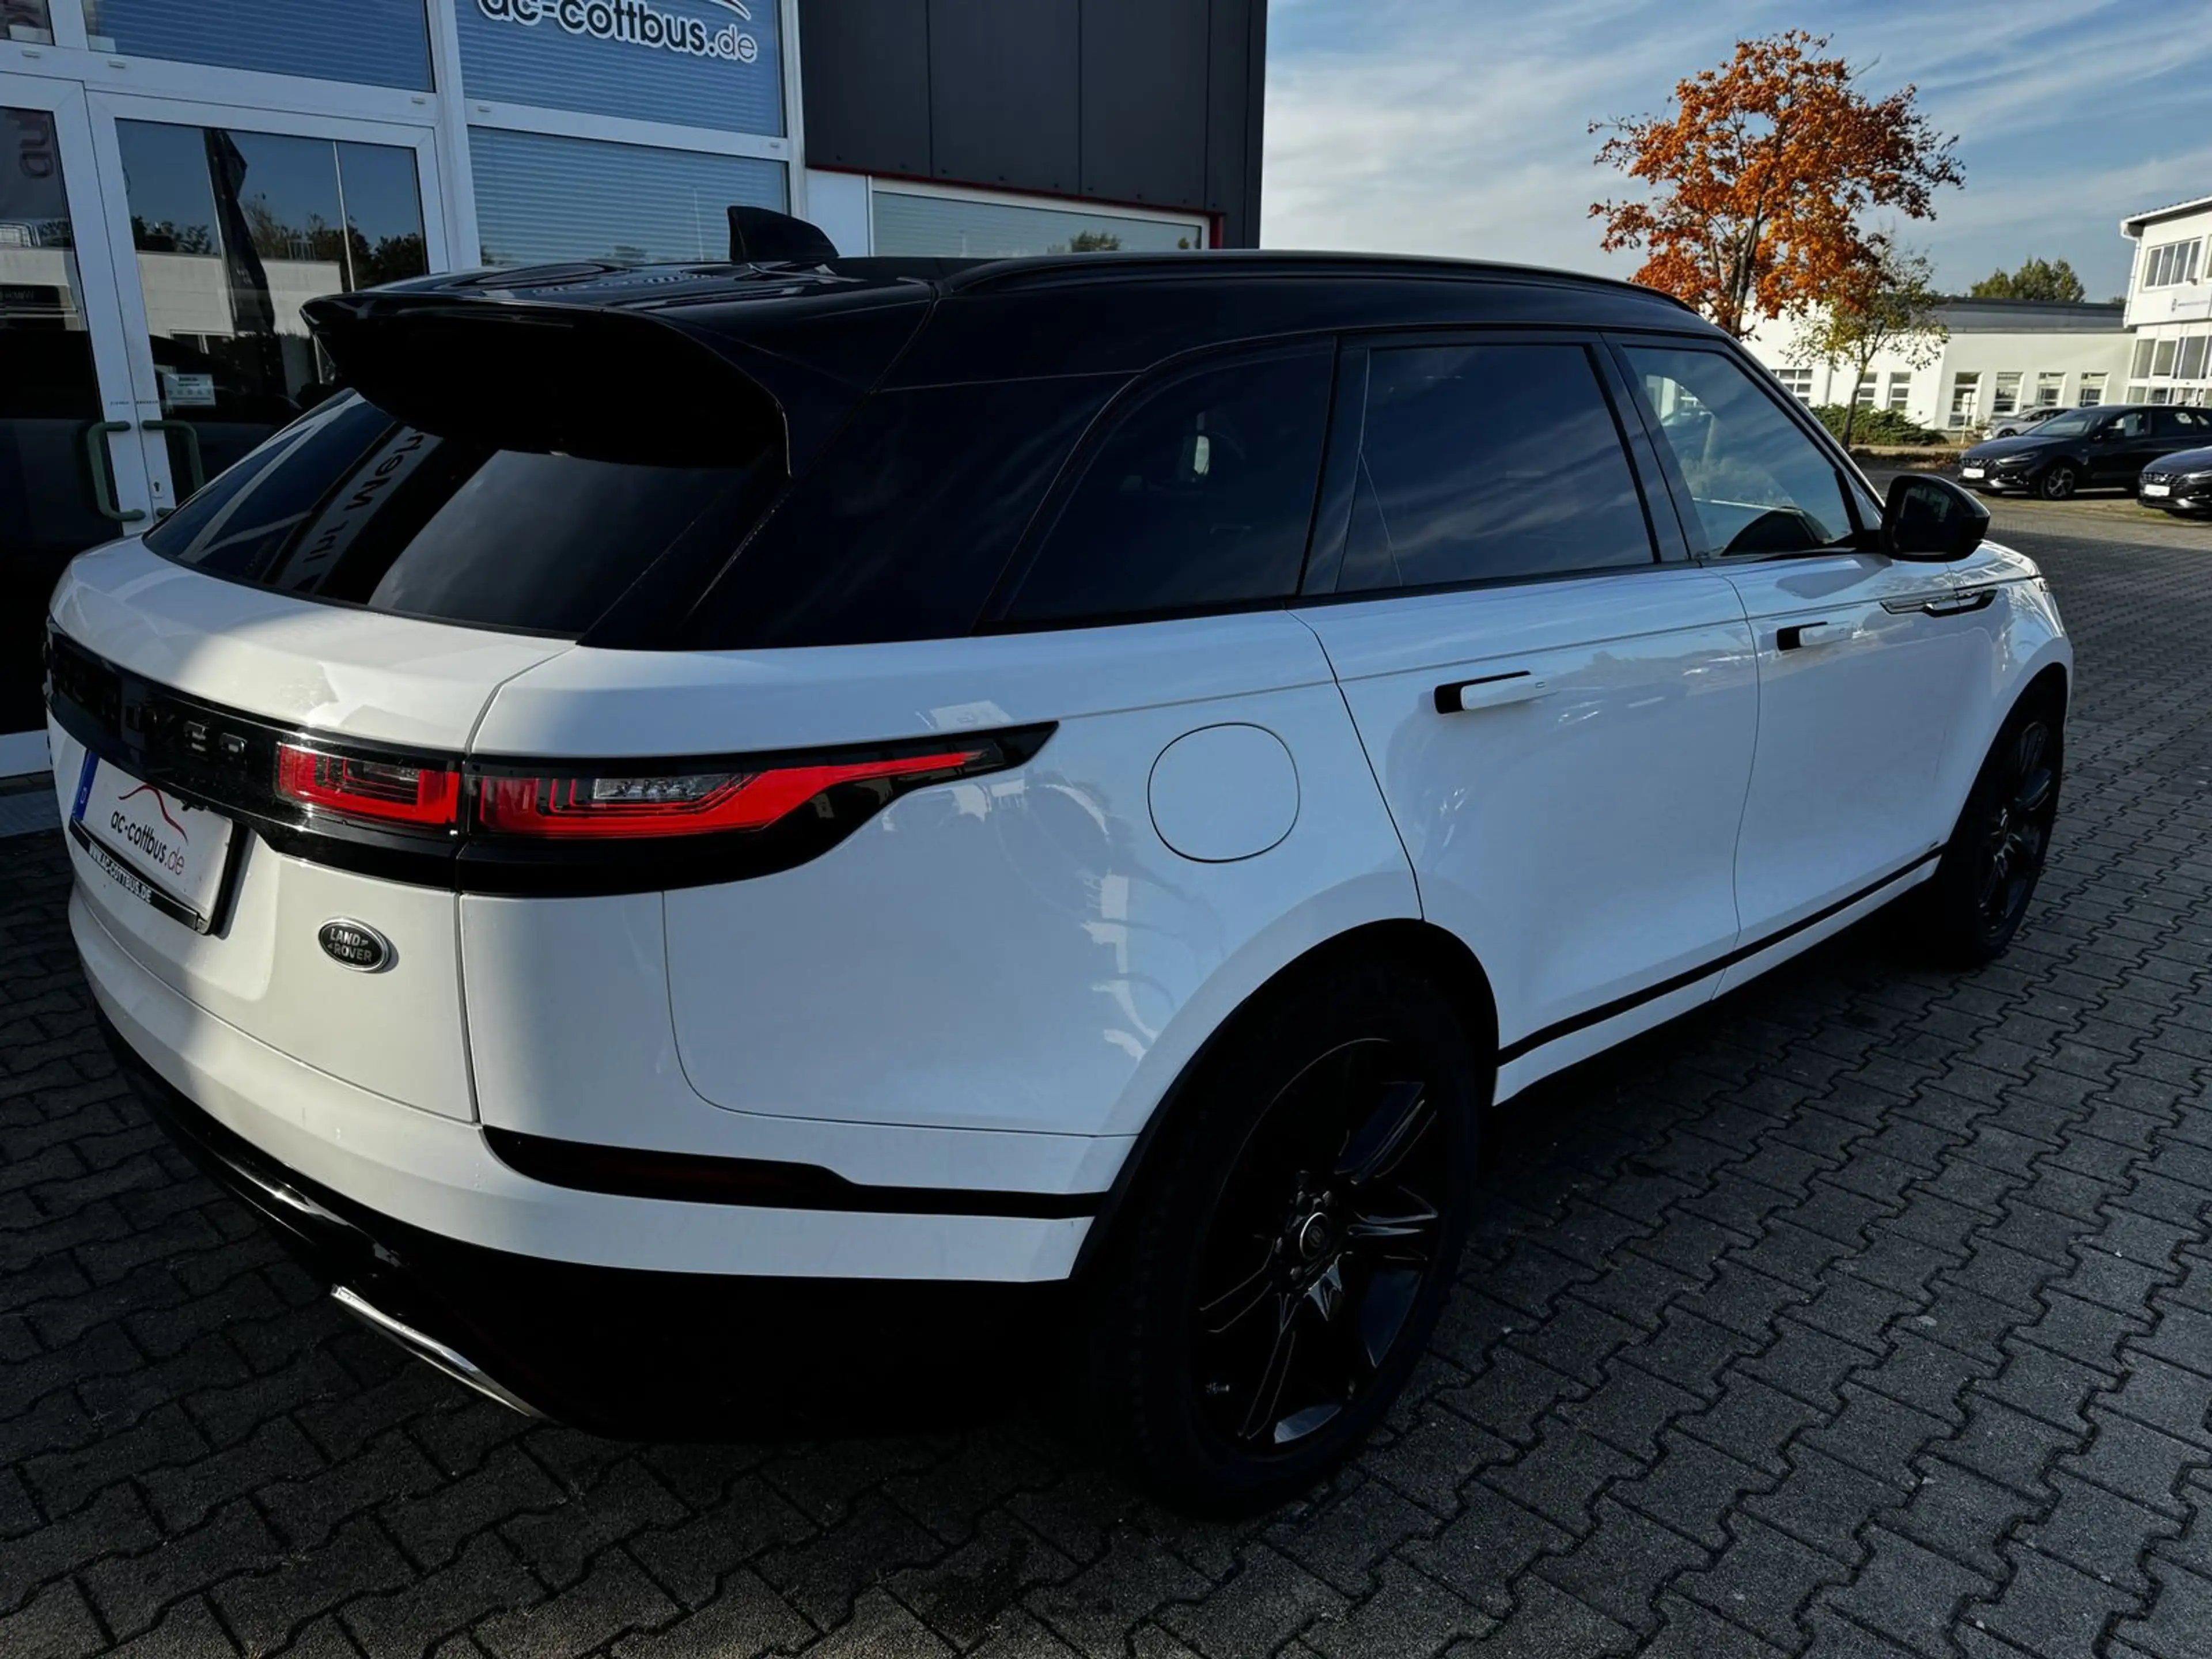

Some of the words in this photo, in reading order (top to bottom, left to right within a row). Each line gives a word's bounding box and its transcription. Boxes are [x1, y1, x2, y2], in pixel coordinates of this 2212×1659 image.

[480, 0, 756, 60] ac-cottbus.de
[111, 809, 184, 876] ac-cottbus.de
[329, 927, 361, 946] LAND
[334, 942, 373, 962] ROVER
